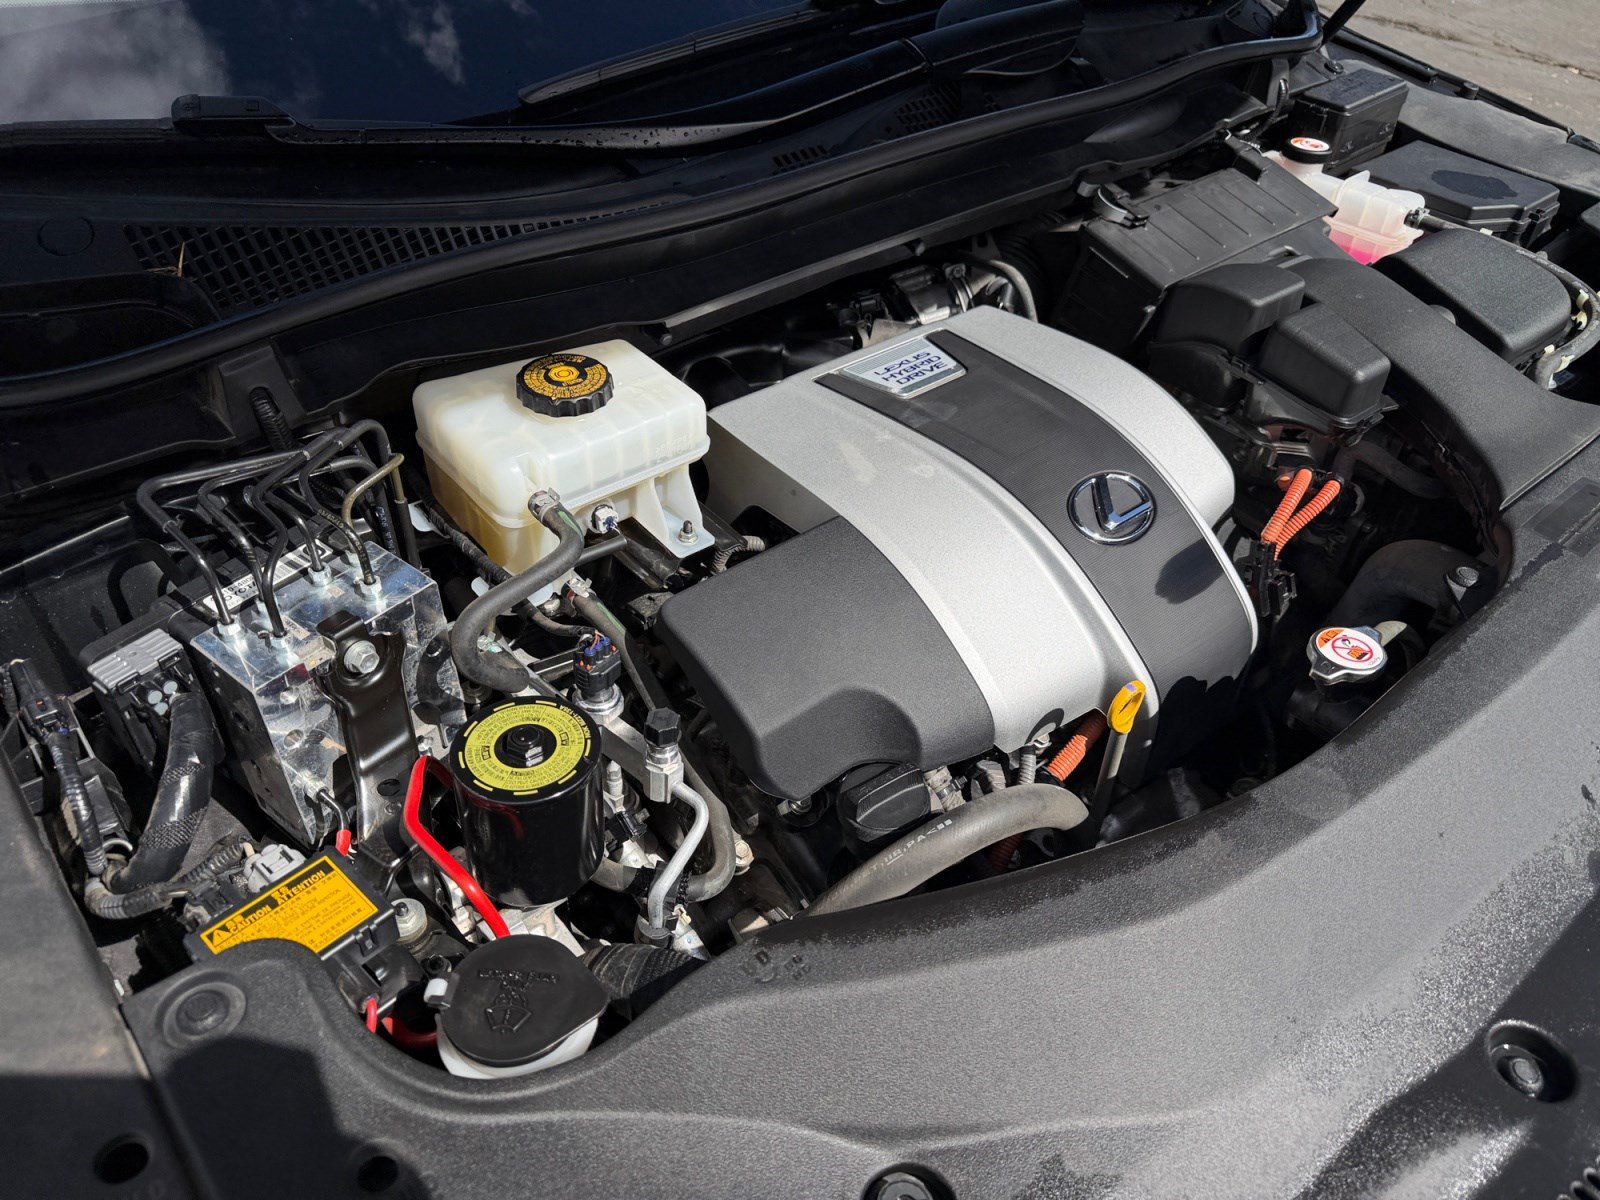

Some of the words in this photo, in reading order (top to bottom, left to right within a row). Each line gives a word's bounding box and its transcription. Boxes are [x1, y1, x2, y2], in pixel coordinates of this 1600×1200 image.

[874, 350, 931, 376] LEXUS
[881, 355, 942, 382] HYBRID
[896, 361, 948, 385] DRIVE
[228, 904, 272, 934] CAUTION
[275, 869, 326, 905] ATTENTION
